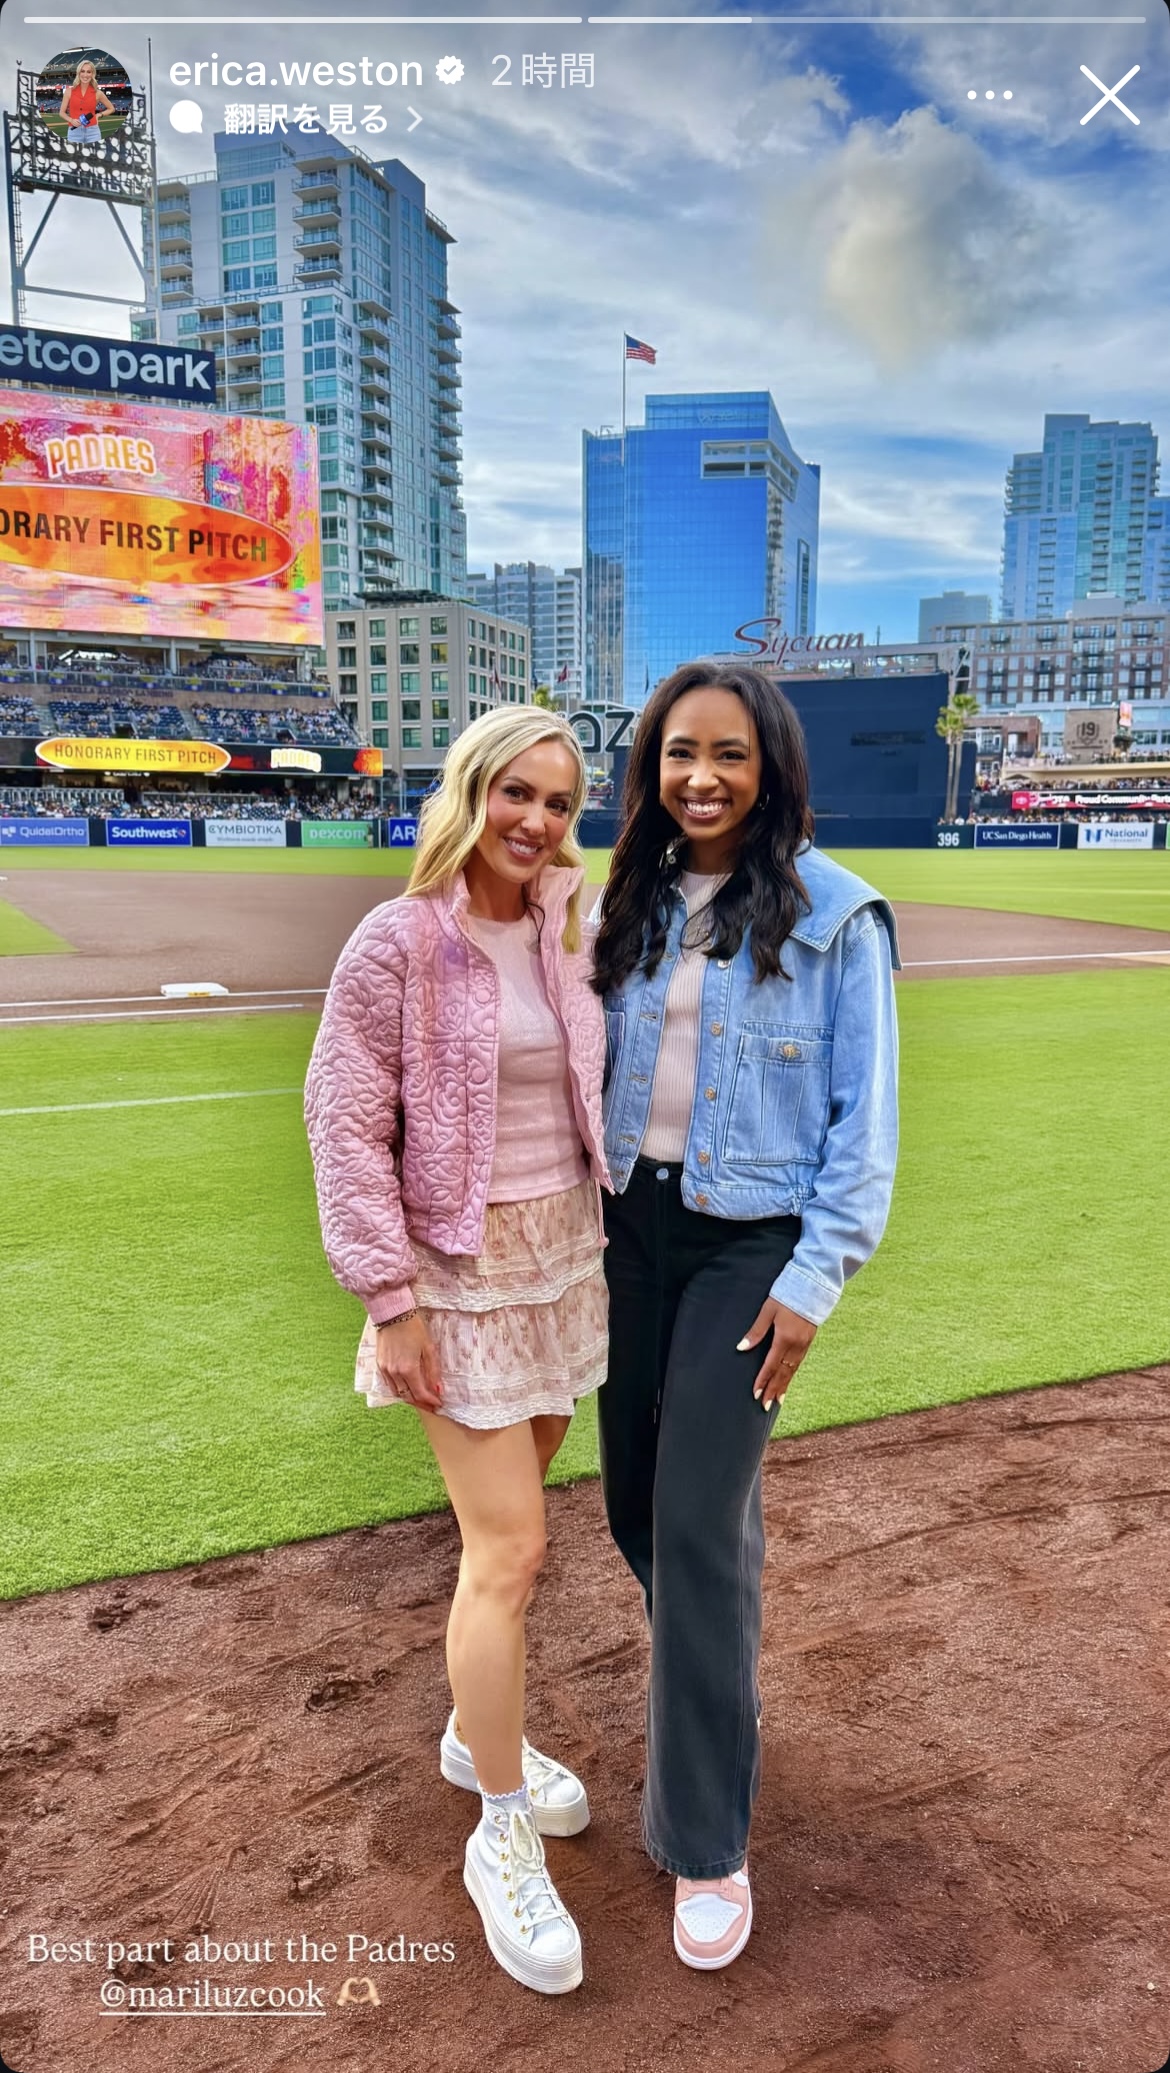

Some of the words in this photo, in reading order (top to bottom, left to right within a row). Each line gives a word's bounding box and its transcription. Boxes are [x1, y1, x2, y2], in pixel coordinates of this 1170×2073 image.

[109, 350, 211, 390] park
[46, 434, 156, 478] PADRES
[100, 519, 179, 553] FIRST
[189, 529, 267, 562] PITCH
[732, 617, 864, 665] Sycuan
[1081, 721, 1096, 737] 19
[54, 744, 131, 761] HONORARY
[136, 748, 174, 762] FIRST
[178, 751, 217, 764] PITCH
[111, 826, 178, 839] Southwest
[937, 832, 960, 847] 396
[982, 831, 994, 840] UC
[994, 831, 1008, 840] San
[1008, 831, 1028, 842] Diego
[1028, 831, 1052, 840] Health
[1105, 828, 1148, 838] National
